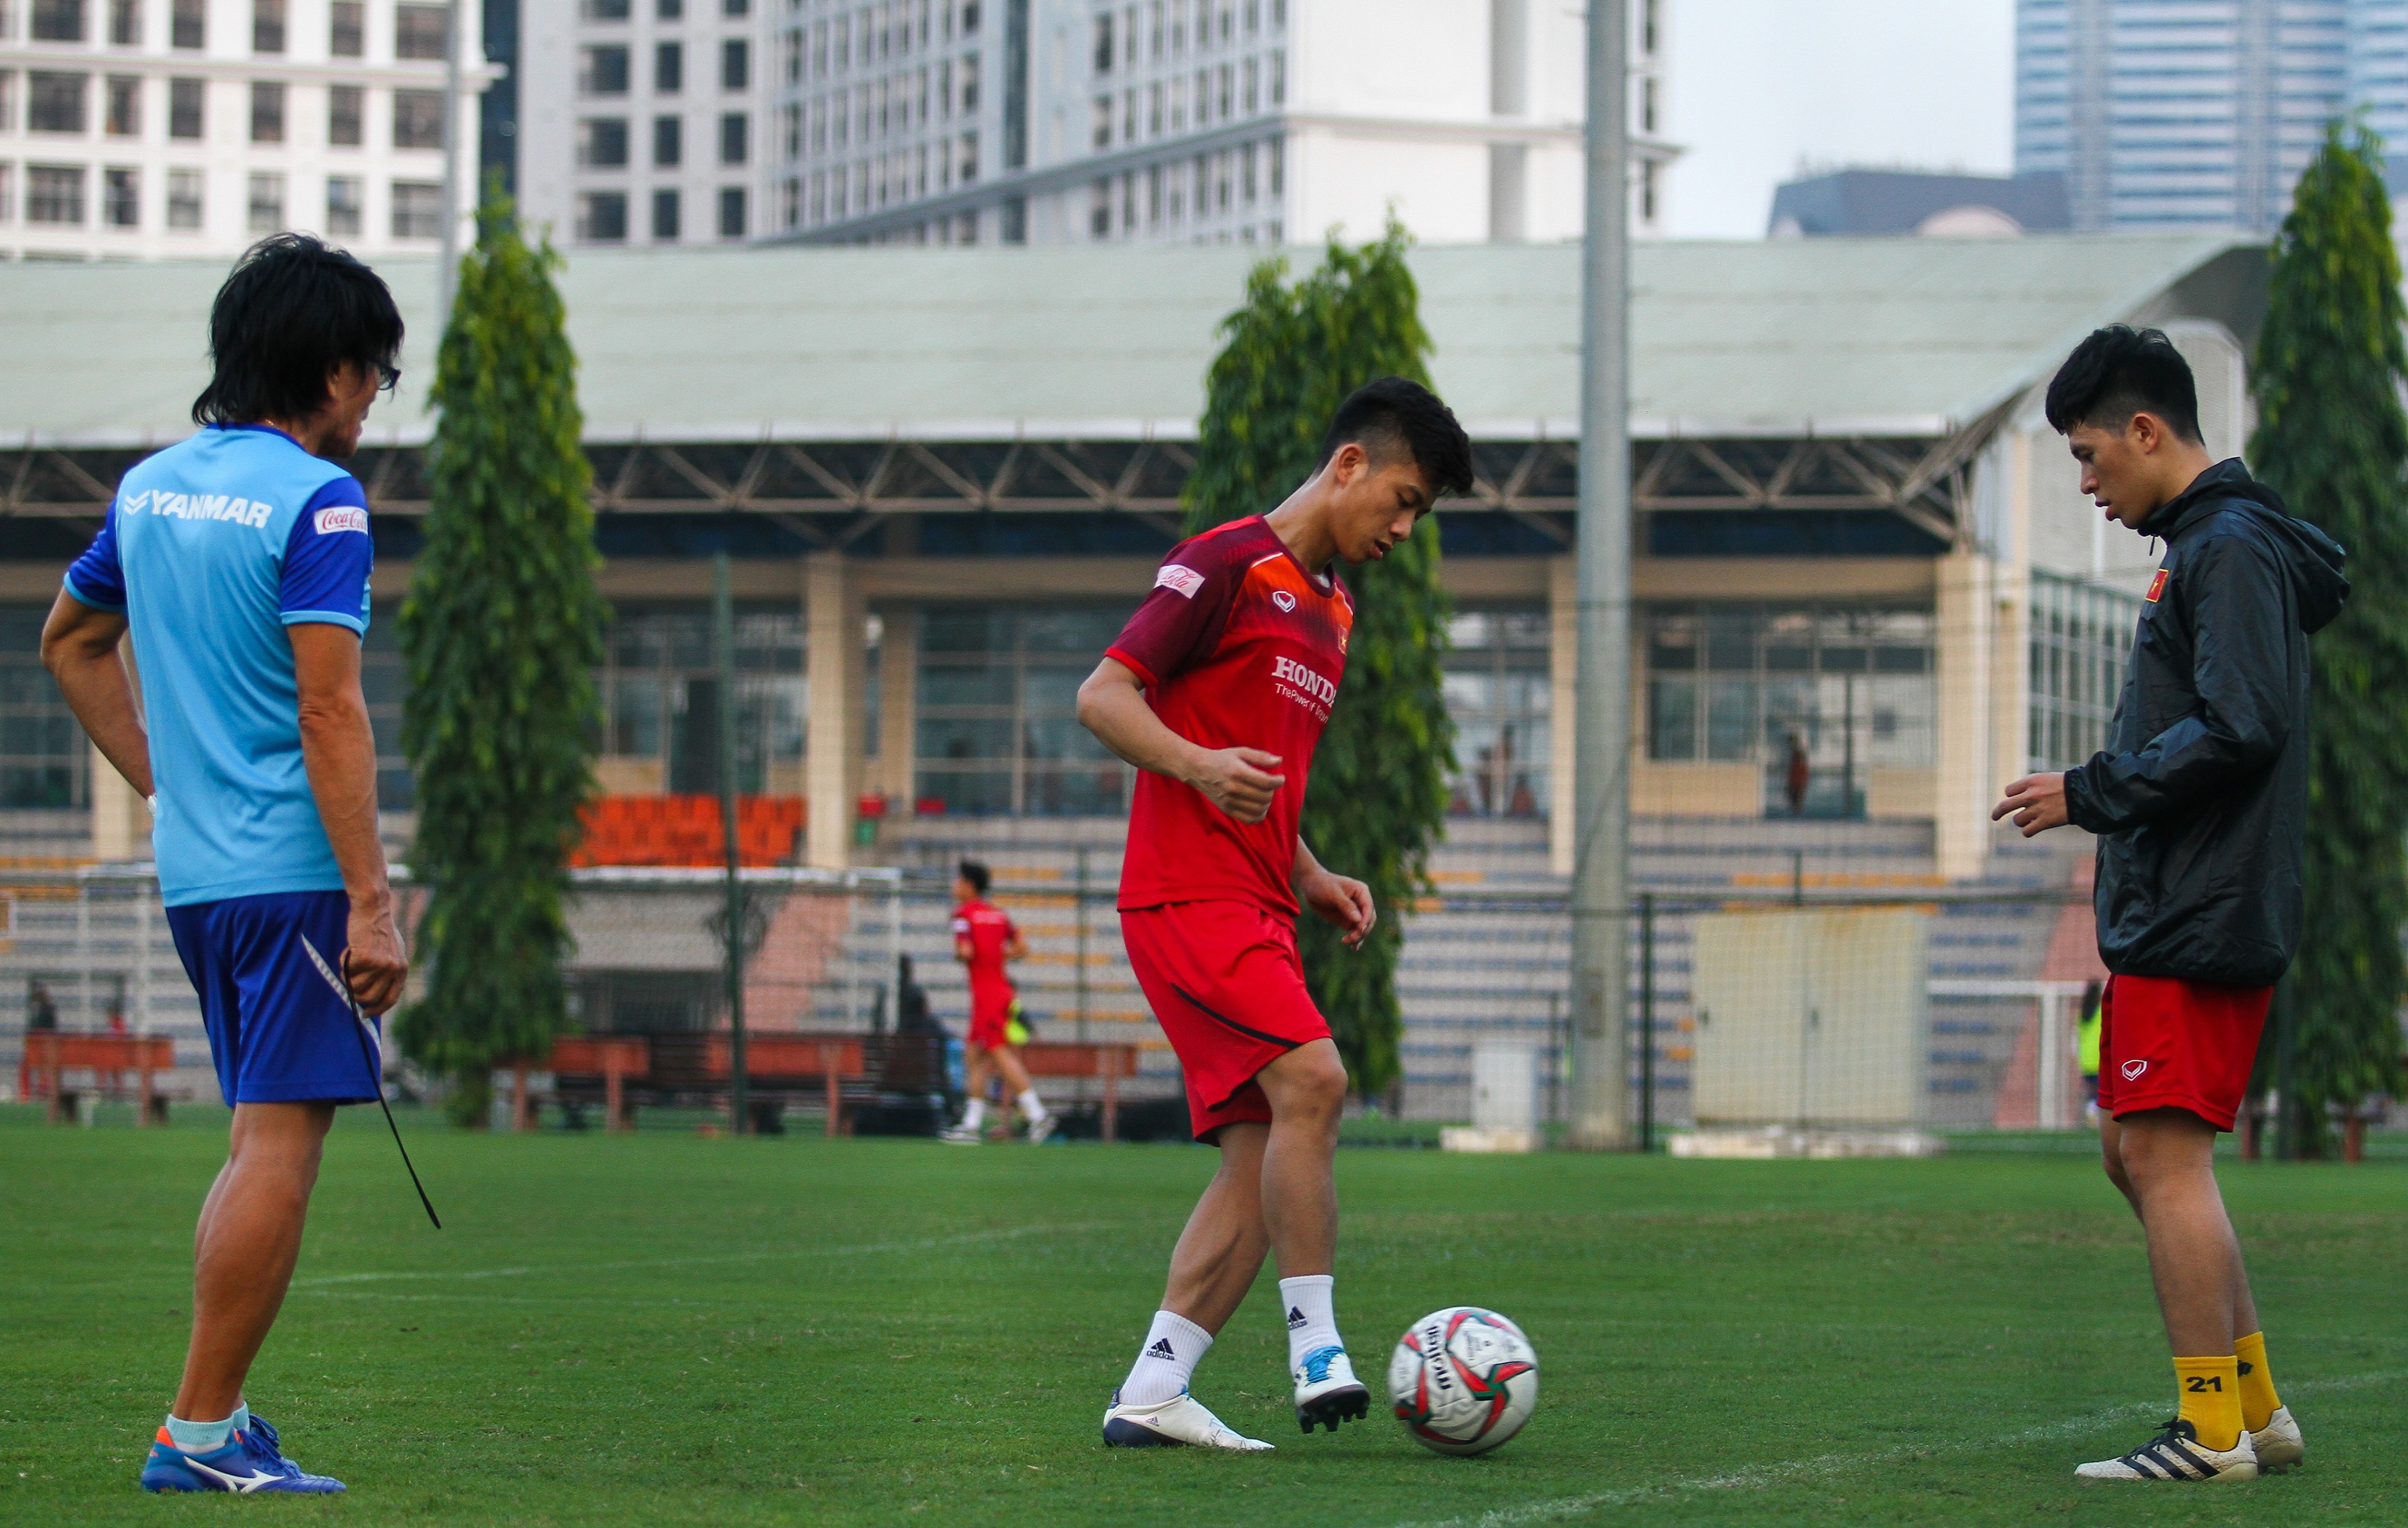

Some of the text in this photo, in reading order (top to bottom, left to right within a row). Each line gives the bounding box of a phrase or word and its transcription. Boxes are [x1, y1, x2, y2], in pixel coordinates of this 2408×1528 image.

[152, 489, 273, 529] YANMAR
[1147, 1349, 1175, 1361] adidas
[2186, 1376, 2222, 1393] 21
